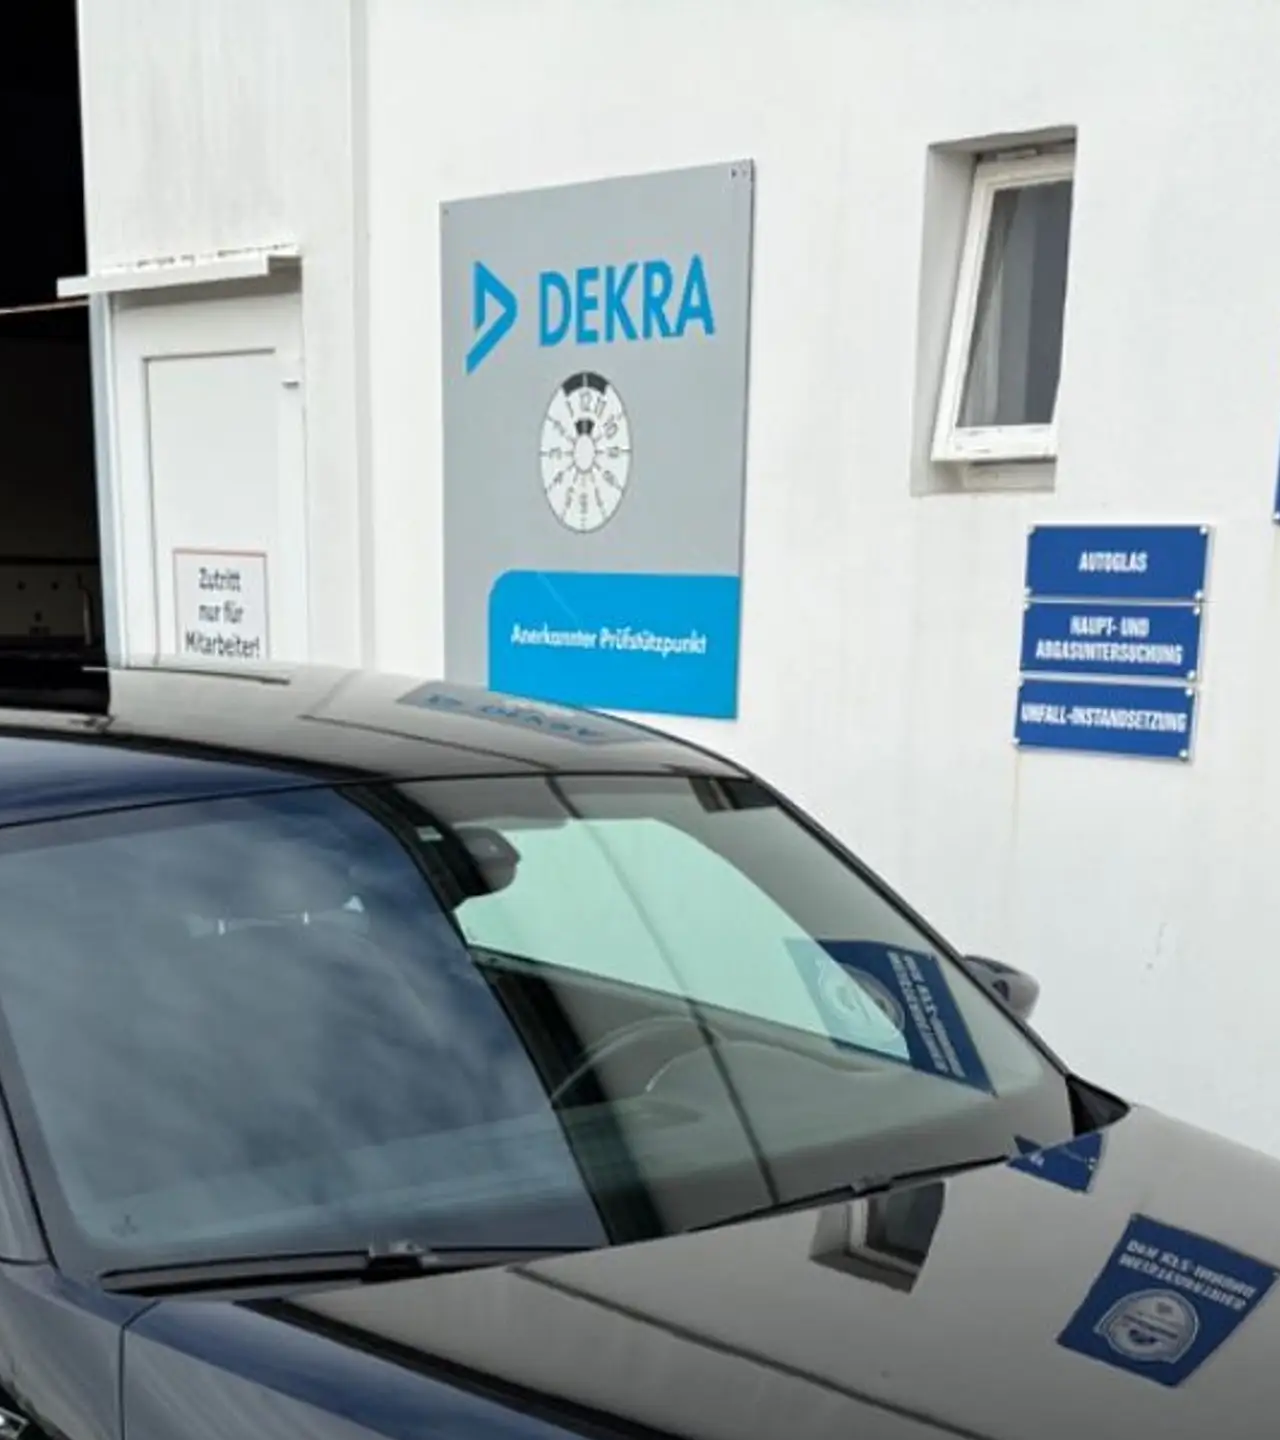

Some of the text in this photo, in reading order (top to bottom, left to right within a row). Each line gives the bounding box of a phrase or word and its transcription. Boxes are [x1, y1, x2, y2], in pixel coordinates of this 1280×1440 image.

[539, 253, 715, 347] DEKRA
[1078, 551, 1148, 573] AUTOGLAS
[199, 567, 241, 592] Zutritt
[199, 600, 243, 624] nur für
[1070, 615, 1150, 638] HAUPT- UND
[185, 630, 260, 659] Mitarbeiter!
[511, 623, 707, 659] Anerkannter Prüfstützpunkt
[1035, 639, 1183, 666] ABGASUNTERSUCHUNG
[1021, 703, 1188, 732] UNFALL-INSTANDSETZUNG
